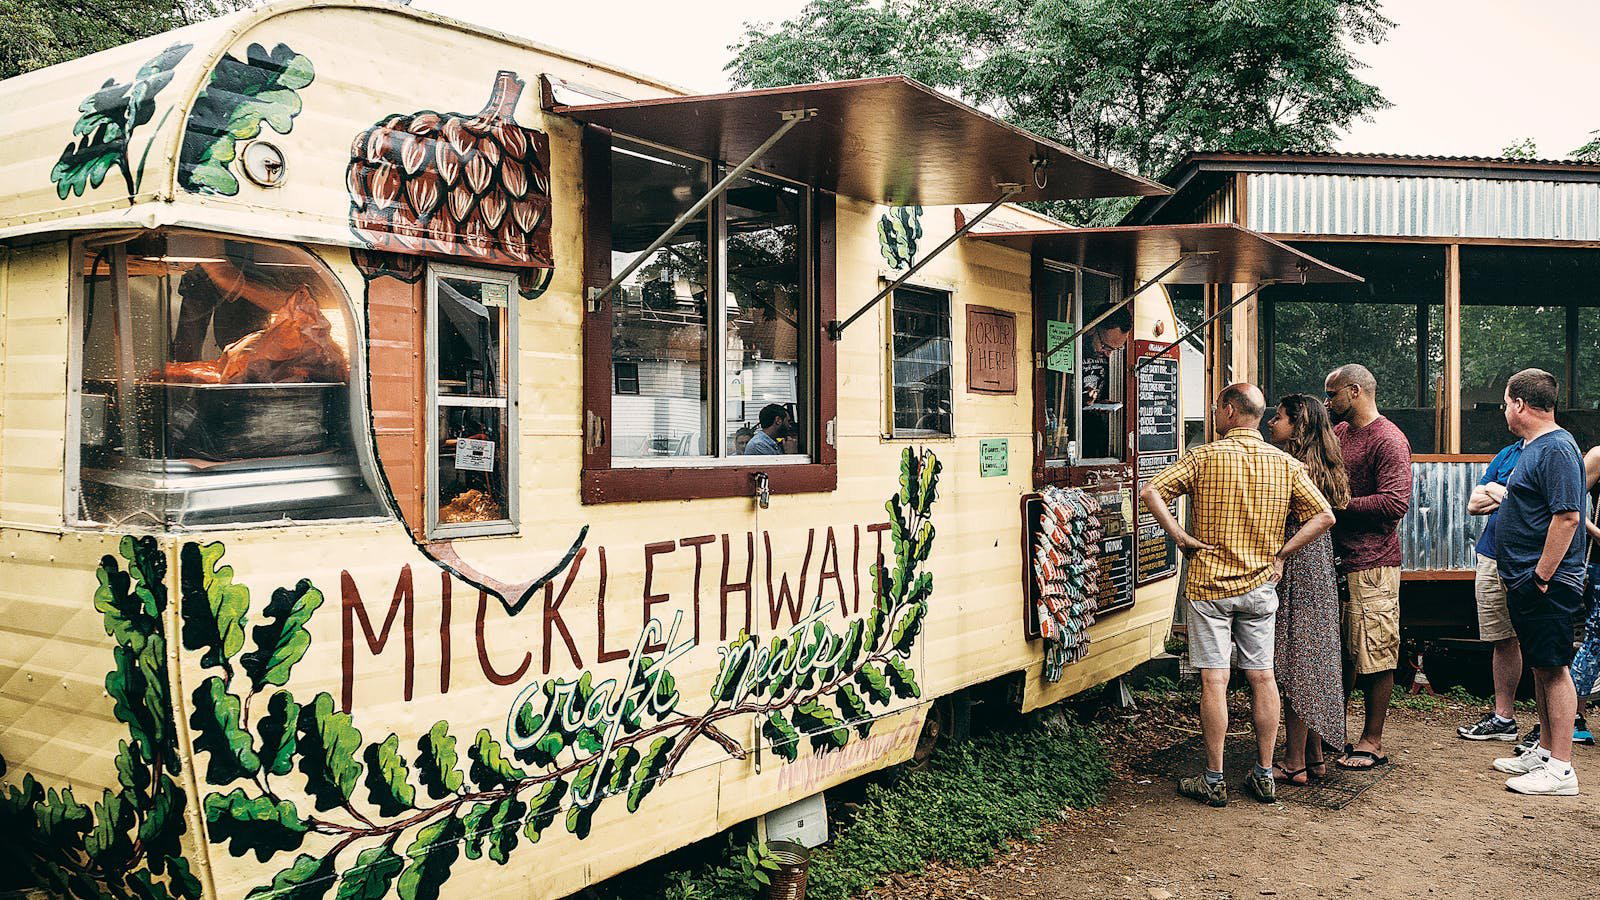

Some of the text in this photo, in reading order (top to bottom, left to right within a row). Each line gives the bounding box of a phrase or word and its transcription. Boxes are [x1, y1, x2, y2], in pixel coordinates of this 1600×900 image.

[976, 322, 1010, 345] ORDER
[978, 348, 1008, 371] HERE
[340, 523, 893, 713] MICKLETHWAIT
